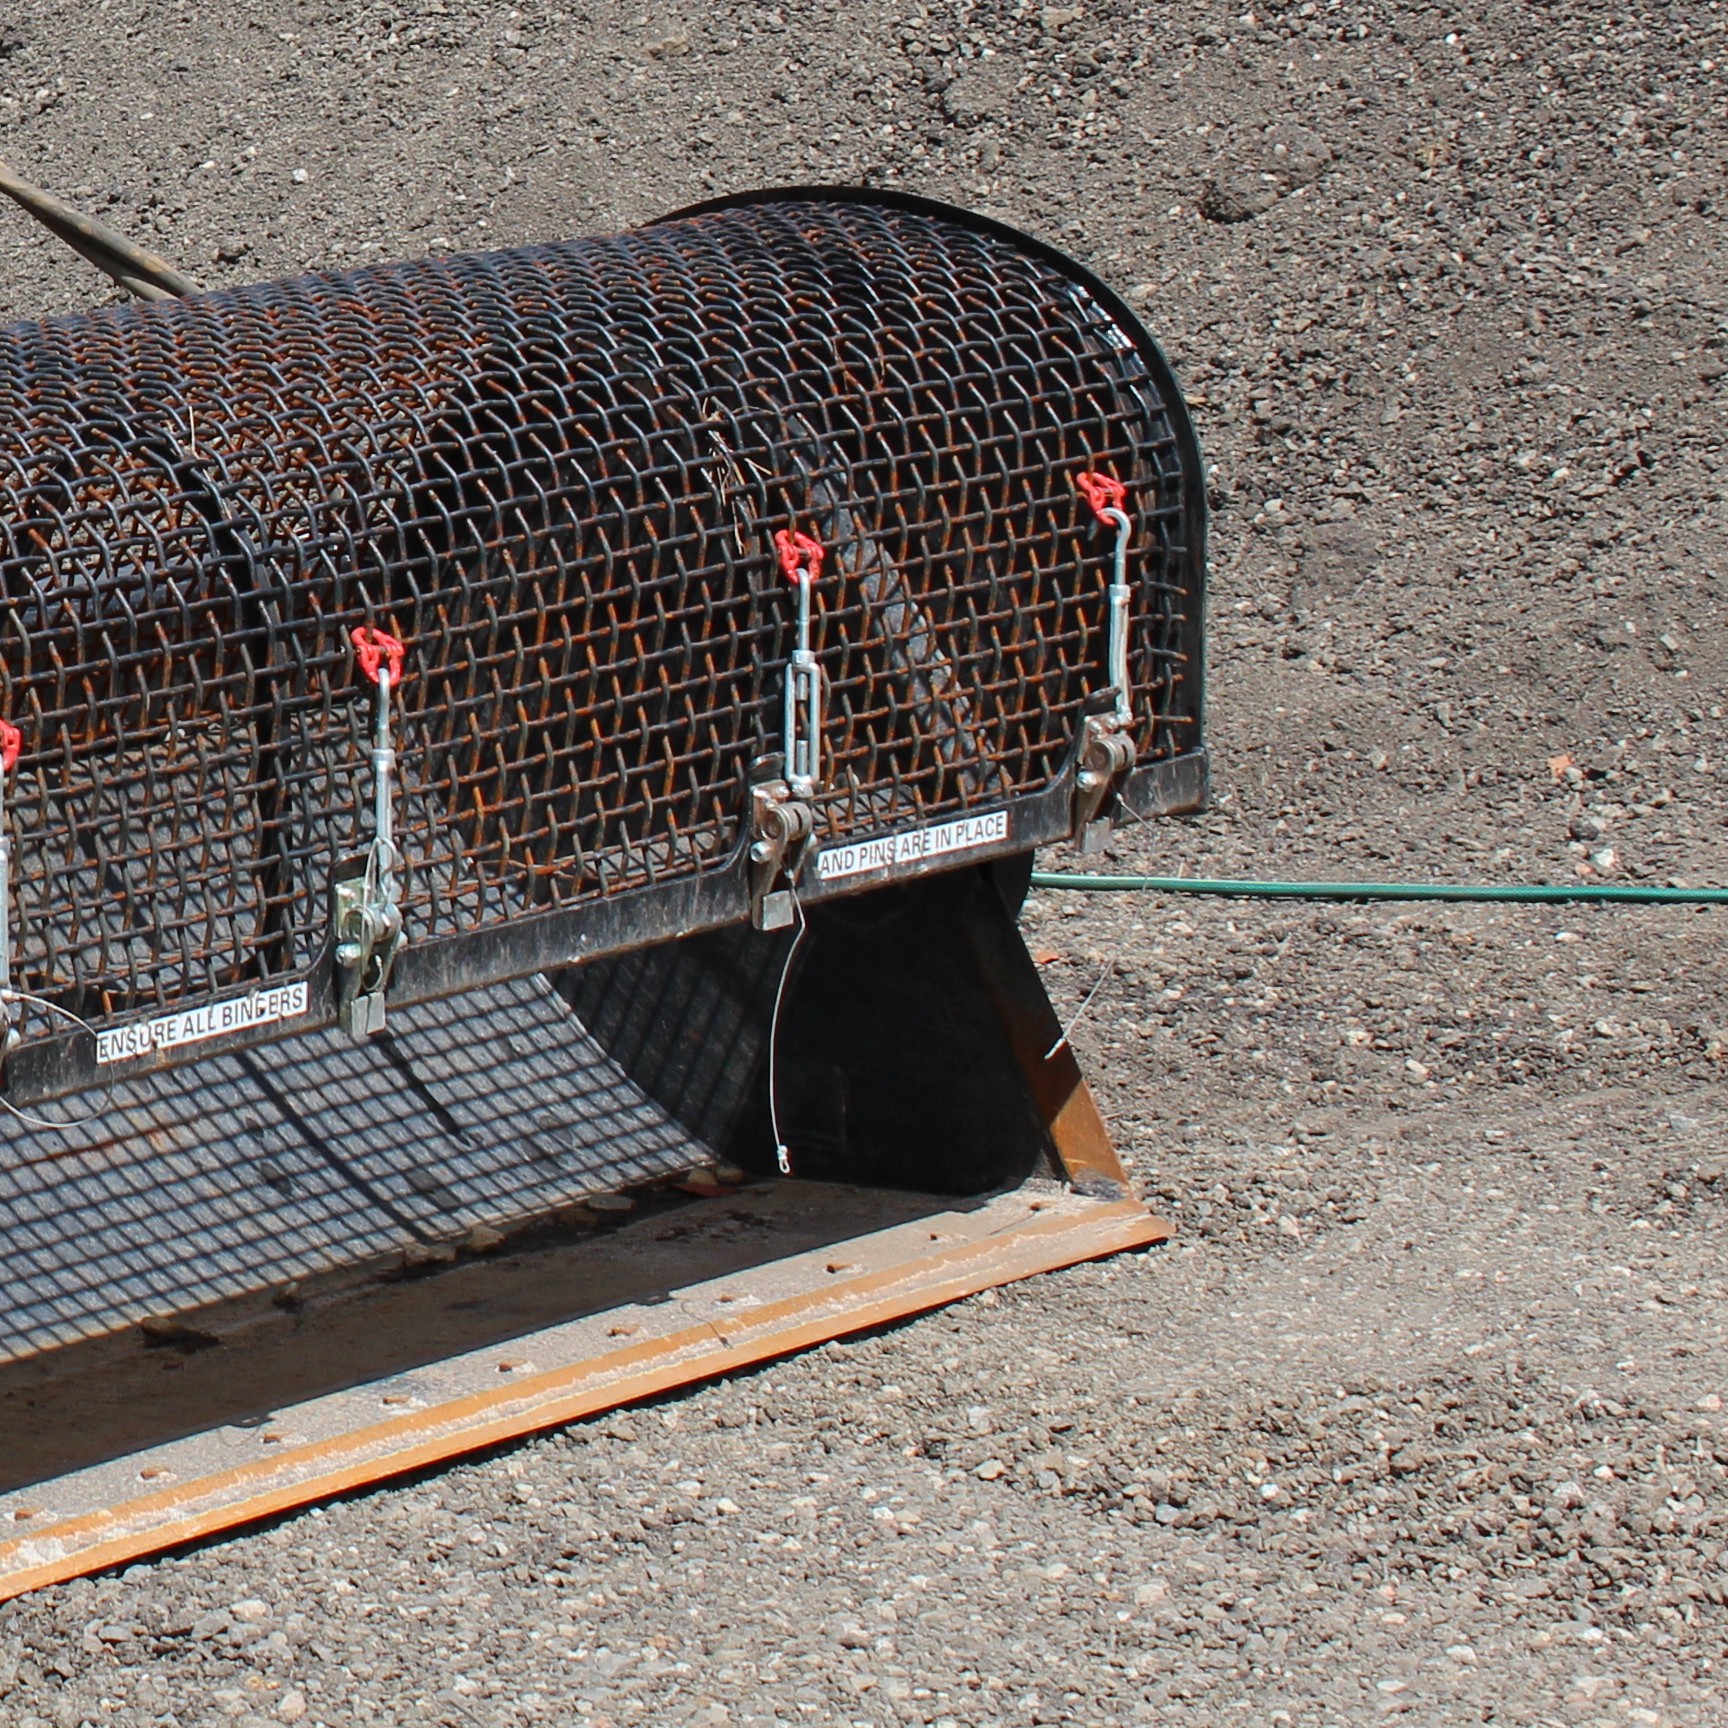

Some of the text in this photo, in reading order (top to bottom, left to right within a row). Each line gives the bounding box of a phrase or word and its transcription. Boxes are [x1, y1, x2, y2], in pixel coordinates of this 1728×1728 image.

[821, 814, 1004, 874] AND PINS ARE IN PLACE
[99, 1020, 177, 1059] ENSURE
[182, 1009, 216, 1039] ALL
